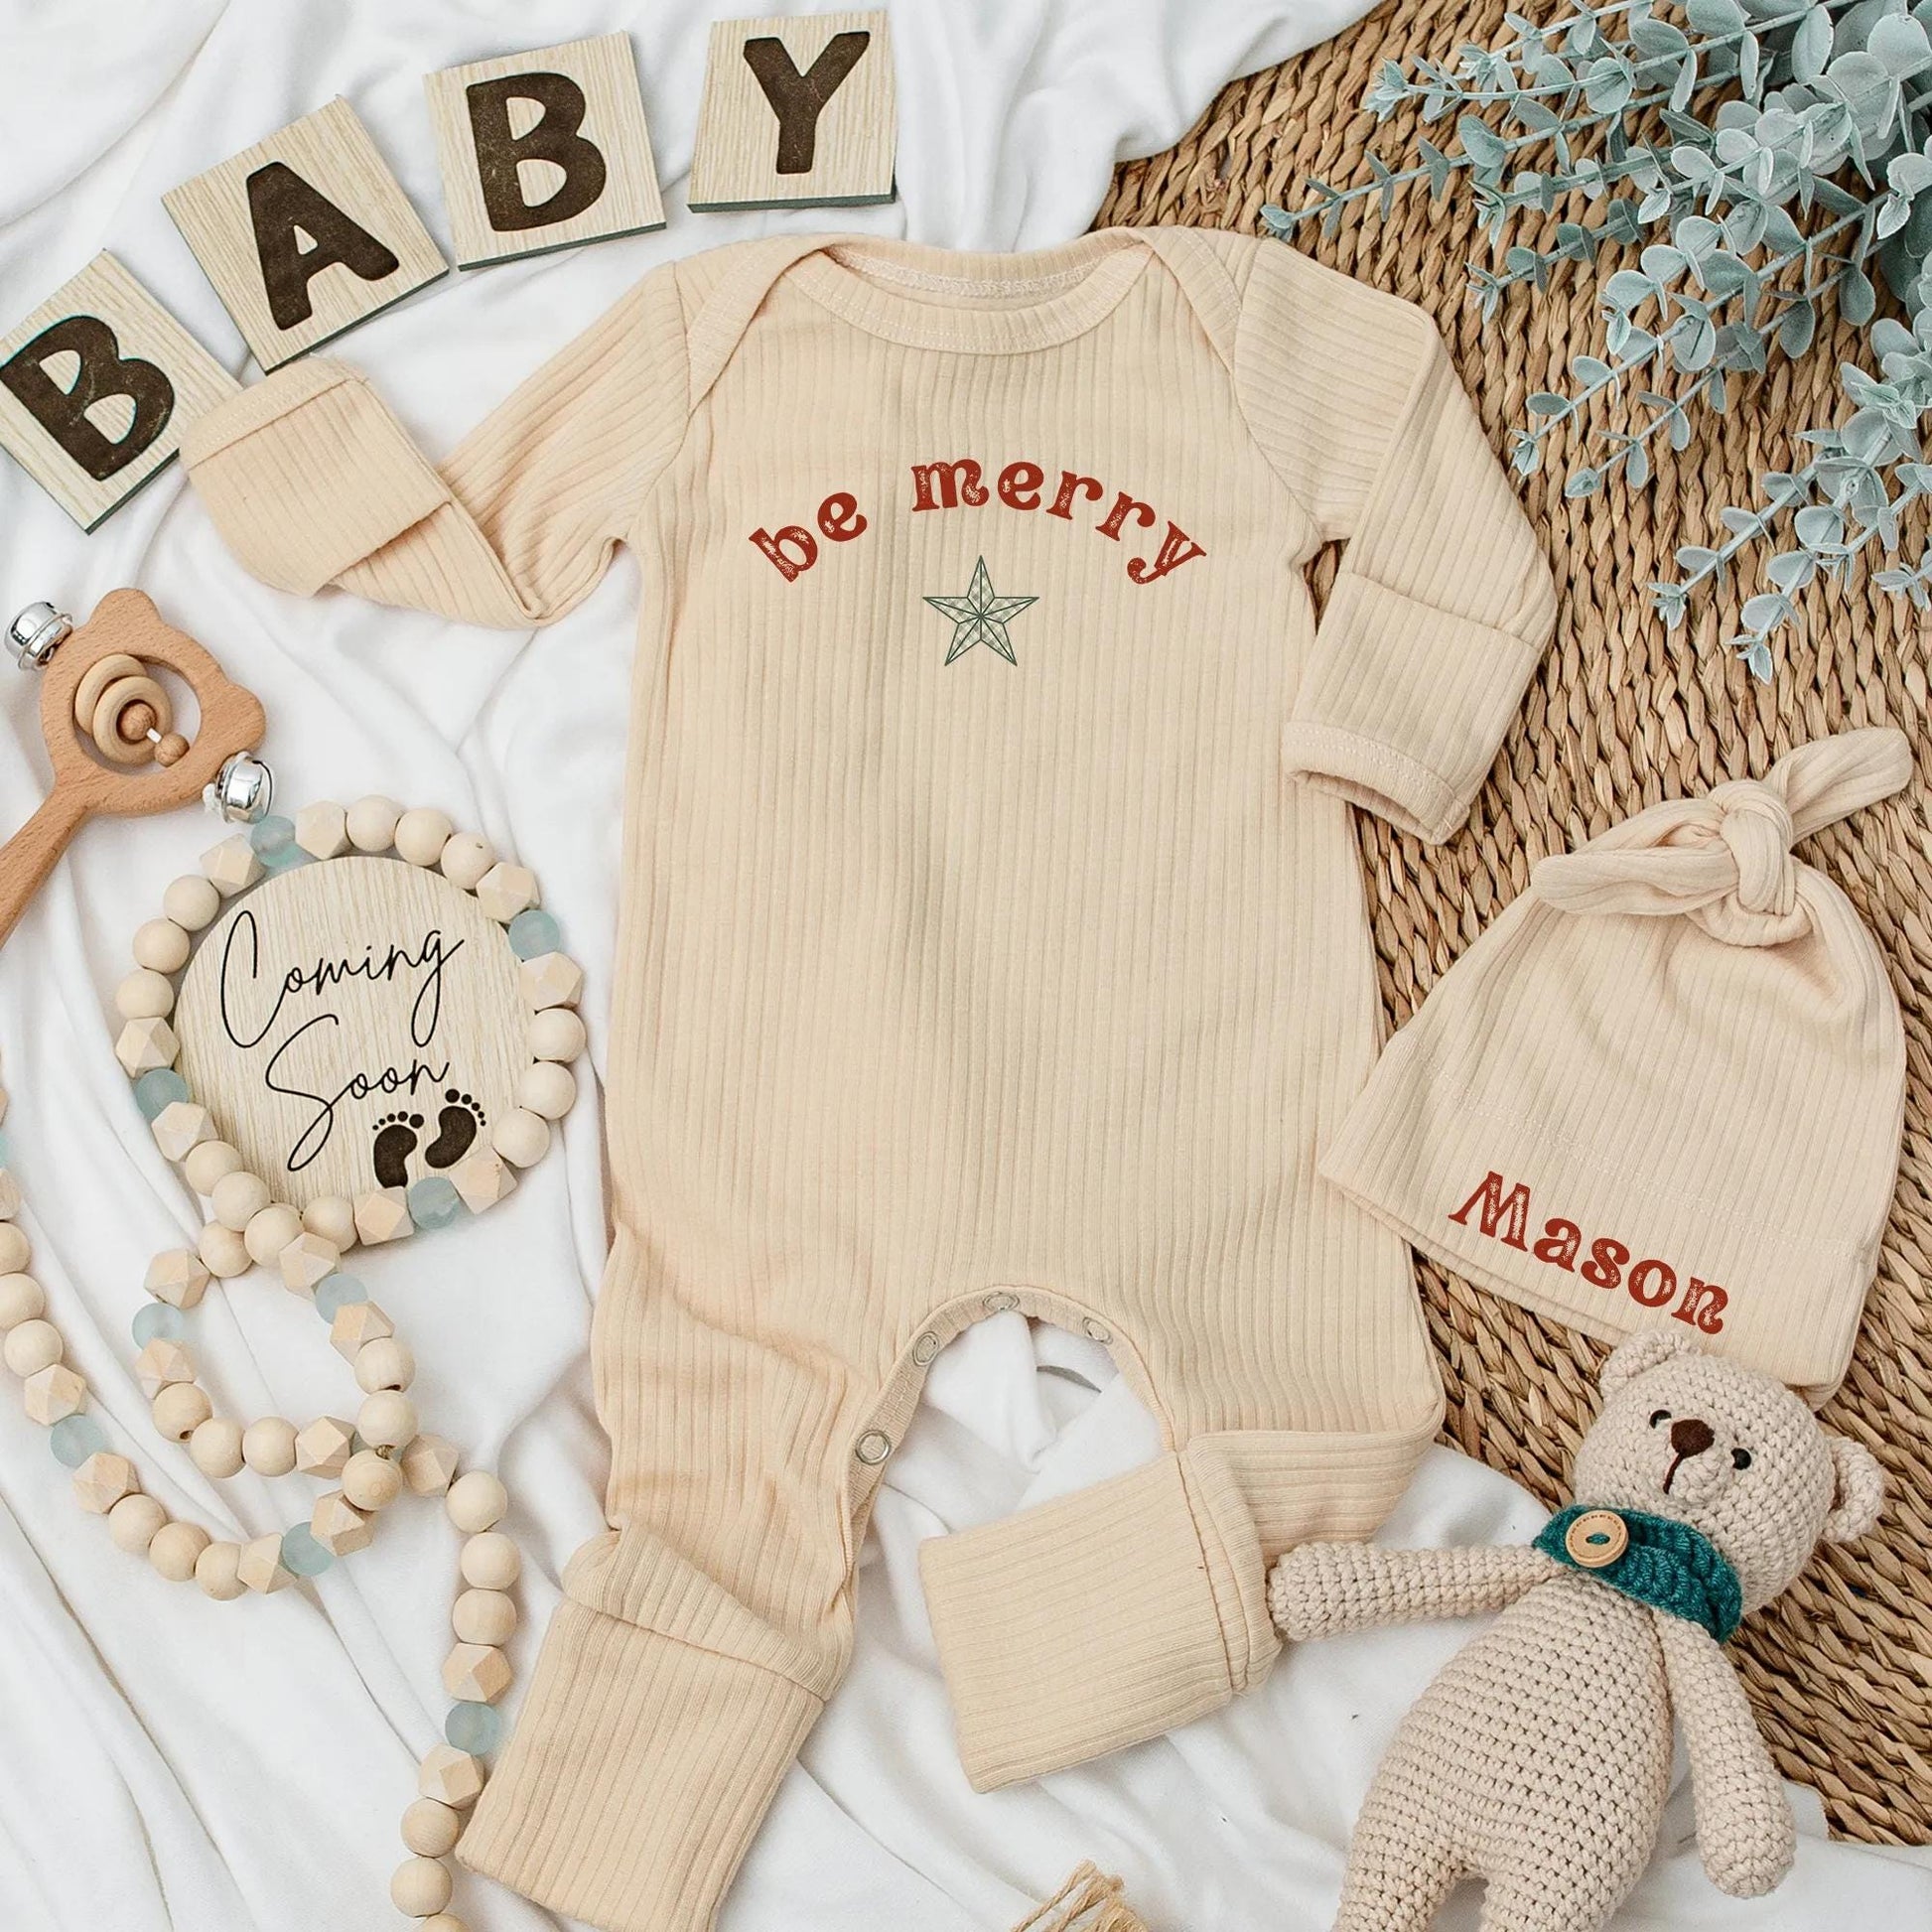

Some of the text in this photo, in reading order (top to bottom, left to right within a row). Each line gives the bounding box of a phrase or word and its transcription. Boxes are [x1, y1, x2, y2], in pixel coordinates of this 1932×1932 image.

[0, 32, 871, 482] BABY
[749, 458, 1206, 586] be merry
[220, 909, 466, 1048] Coming
[265, 1014, 451, 1172] Soon
[1449, 1171, 1729, 1335] Mason
